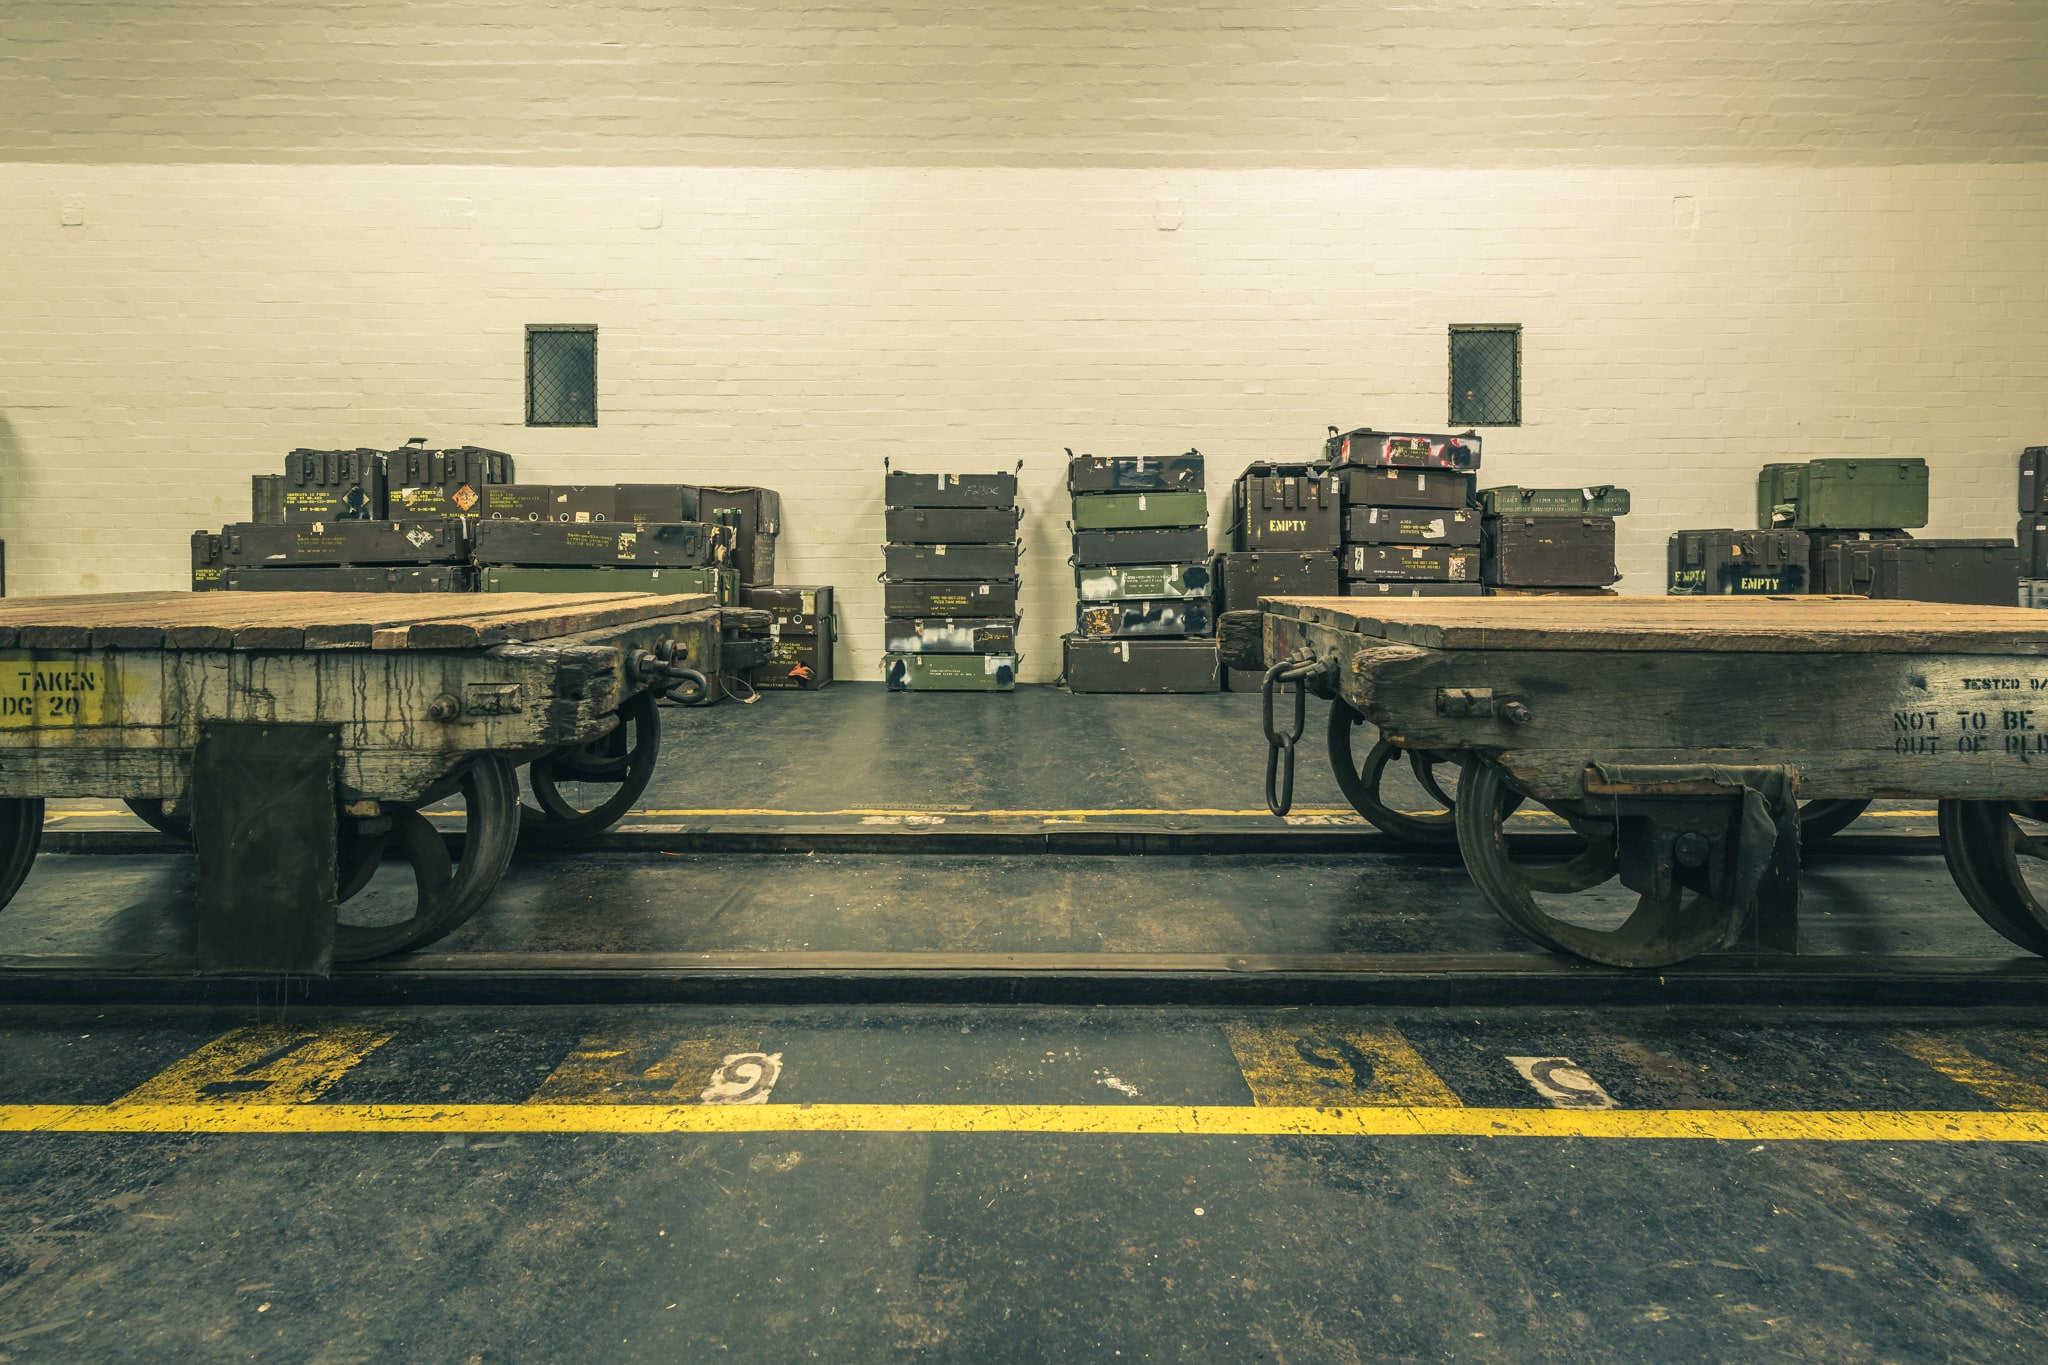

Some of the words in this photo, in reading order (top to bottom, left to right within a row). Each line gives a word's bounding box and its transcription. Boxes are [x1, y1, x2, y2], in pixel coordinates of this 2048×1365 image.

[1269, 519, 1307, 532] EMPTY
[1674, 569, 1706, 582] EMPTY
[1741, 577, 1779, 591] EMPTY
[18, 671, 95, 691] TAKEN
[1961, 678, 2020, 690] TESTED
[50, 696, 80, 717] 20
[1893, 711, 1939, 731] NOT
[1956, 711, 1987, 730] TO
[2002, 710, 2035, 731] BE
[1894, 735, 1941, 755] OUT
[1957, 735, 1988, 754] OF
